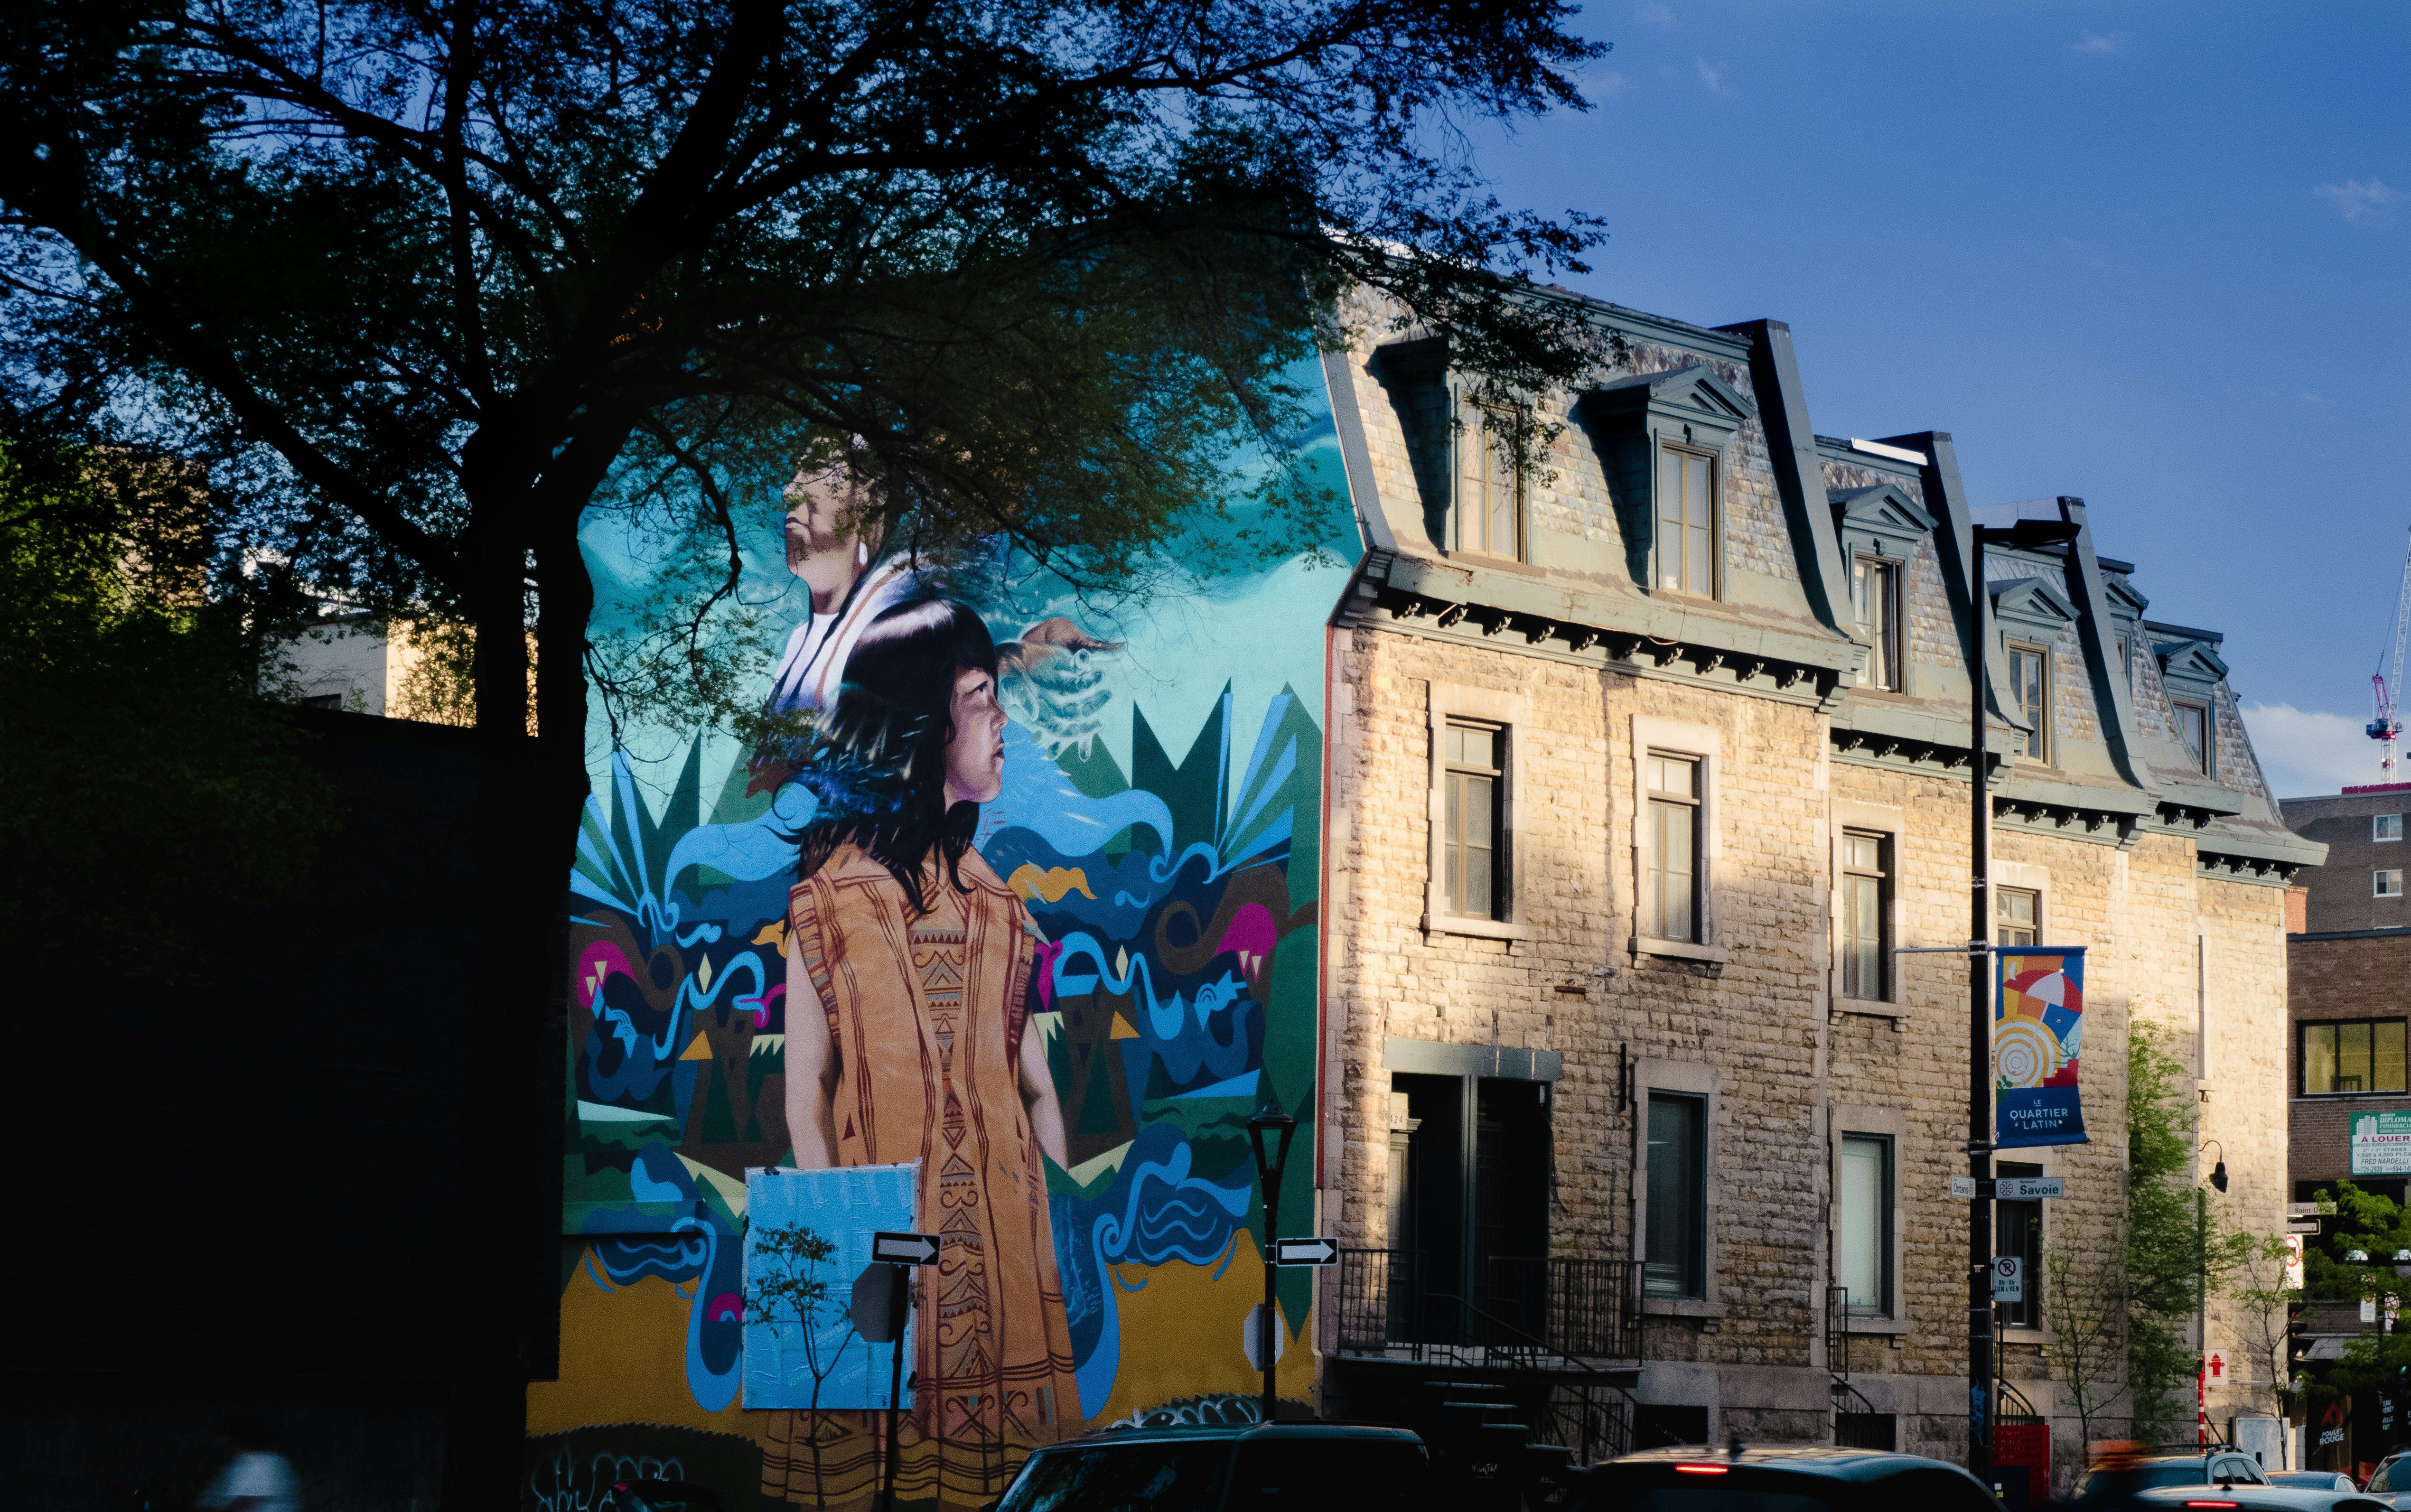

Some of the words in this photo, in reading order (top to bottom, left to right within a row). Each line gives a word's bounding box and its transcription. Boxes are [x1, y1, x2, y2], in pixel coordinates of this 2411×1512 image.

[2009, 1108, 2068, 1120] QUARTIER
[2023, 1120, 2057, 1129] LATIN
[1953, 1183, 1969, 1194] Ontario
[2020, 1185, 2059, 1195] Savoie
[2322, 1428, 2343, 1437] POULET
[2319, 1433, 2344, 1445] ROUGE
